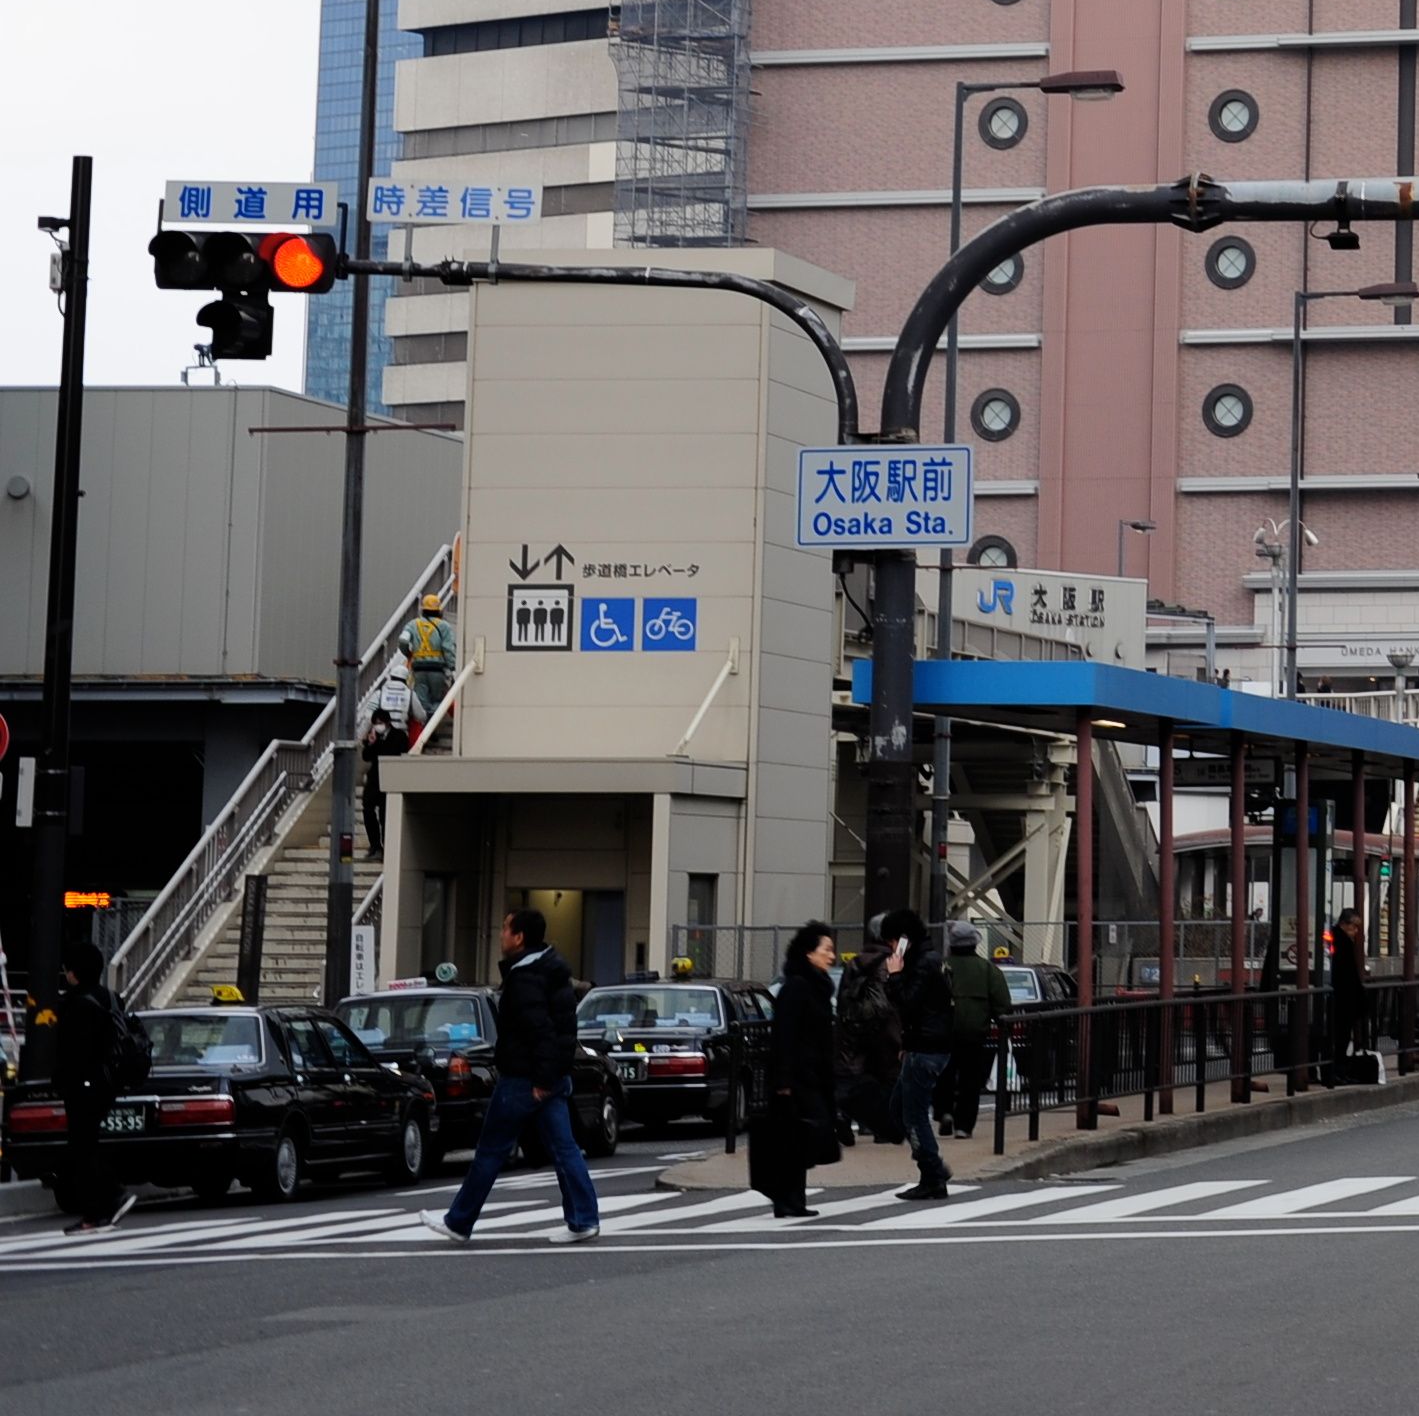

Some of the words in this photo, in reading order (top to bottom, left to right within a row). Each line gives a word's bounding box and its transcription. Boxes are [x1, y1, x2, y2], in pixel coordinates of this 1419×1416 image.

[179, 184, 325, 220] 側道用
[372, 185, 536, 220] 時差信号
[815, 456, 954, 504] 大阪駅前
[813, 512, 893, 536] Osaka
[906, 511, 954, 535] Sta.
[582, 562, 700, 579] 歩道橋エレベータ
[977, 579, 1016, 616] JR
[1031, 583, 1105, 613] 大阪駅
[1031, 609, 1063, 625] OSAKA
[1066, 614, 1106, 628] STATION
[1341, 646, 1382, 656] UMEDA
[354, 932, 365, 997] 自転車はエレ
[107, 1115, 144, 1131] 55-95
